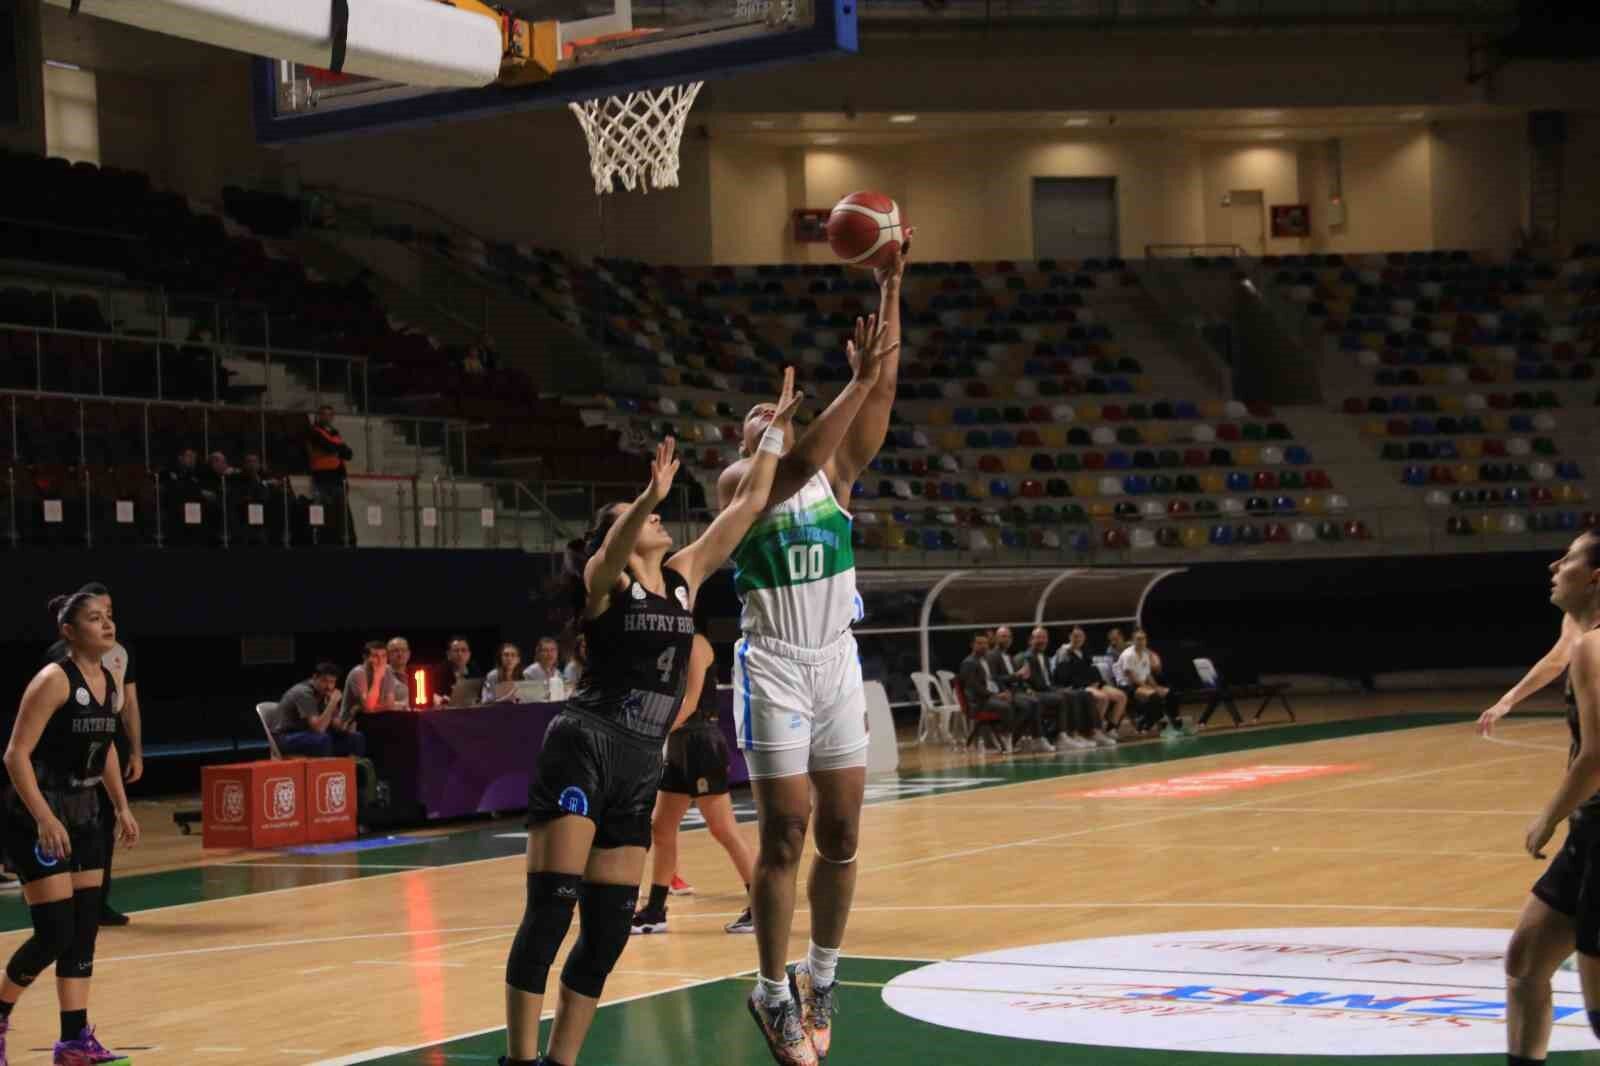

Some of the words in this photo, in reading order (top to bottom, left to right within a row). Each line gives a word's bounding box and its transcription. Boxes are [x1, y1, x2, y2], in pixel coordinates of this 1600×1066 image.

[788, 543, 825, 580] 00
[624, 613, 675, 632] HATAY
[656, 646, 677, 683] 4
[414, 669, 427, 705] 1
